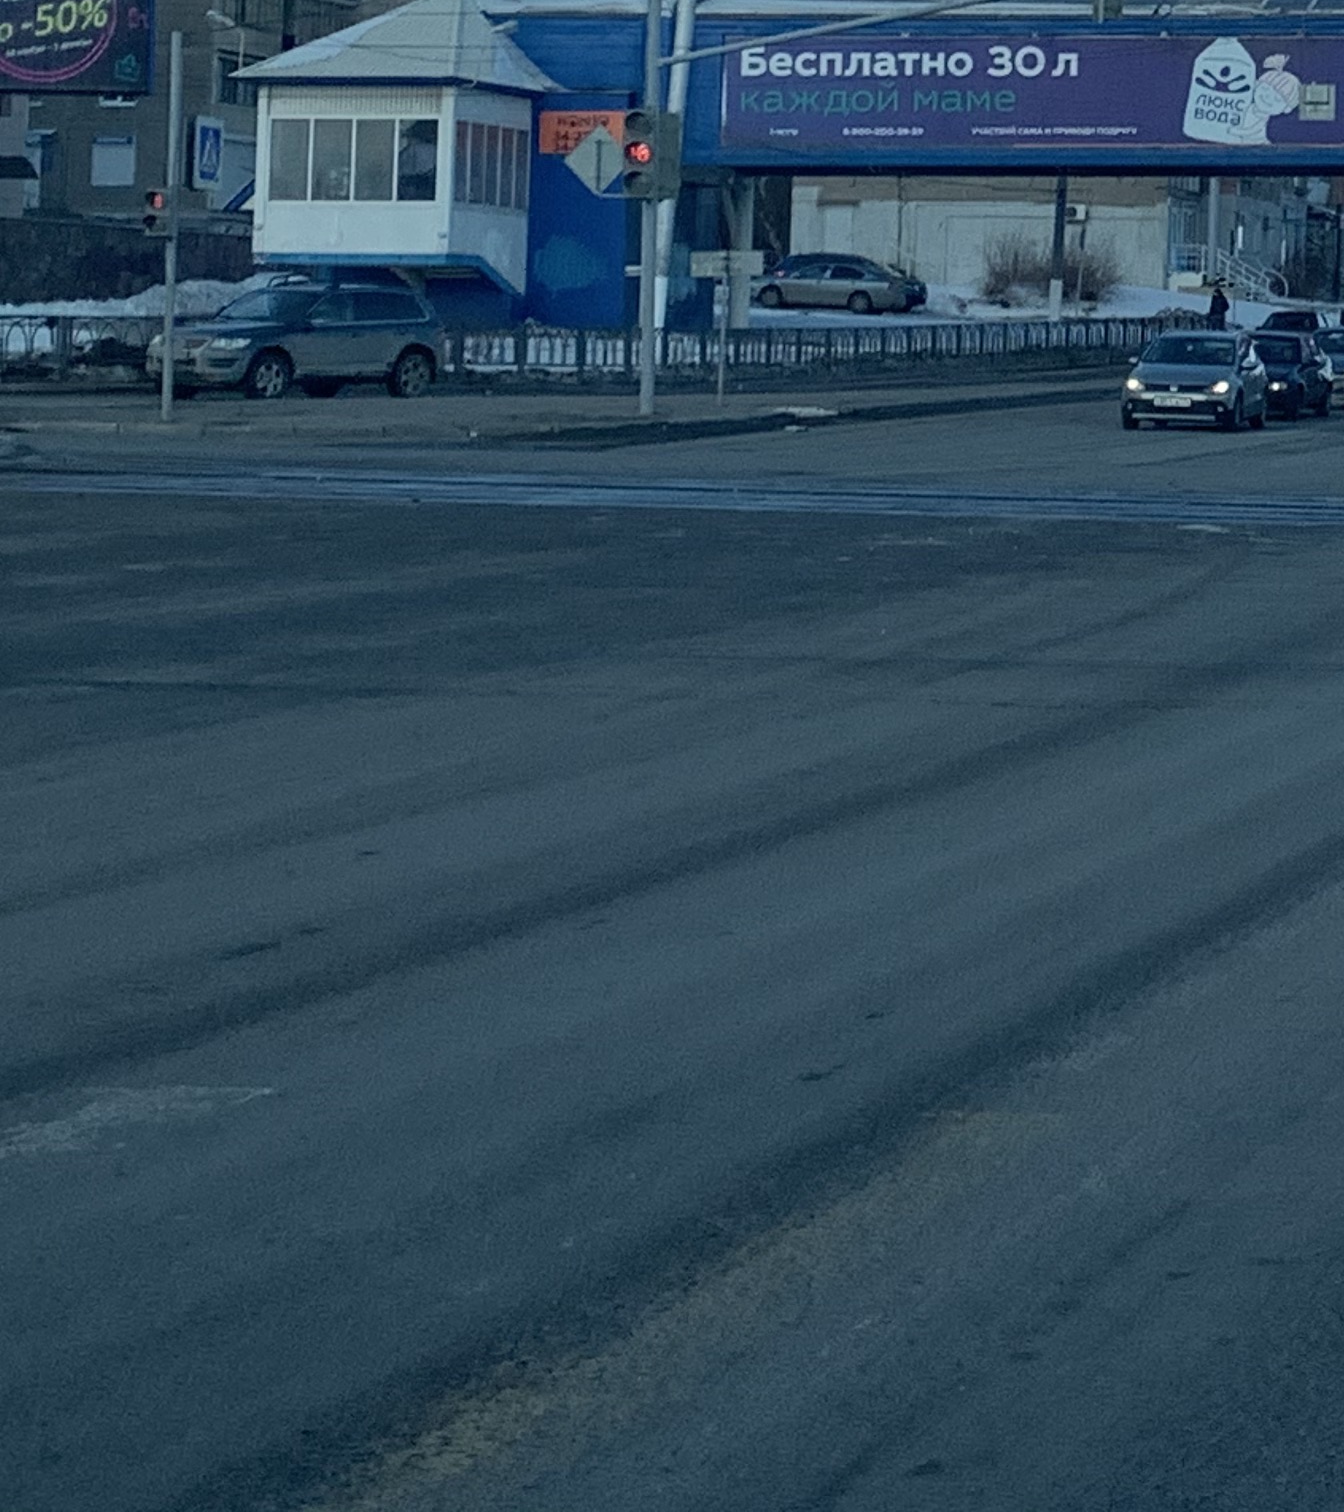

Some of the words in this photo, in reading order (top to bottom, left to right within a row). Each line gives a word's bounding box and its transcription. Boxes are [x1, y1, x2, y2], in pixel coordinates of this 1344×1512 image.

[740, 46, 974, 77] Бесплатно
[987, 46, 1046, 77] 30
[1051, 51, 1080, 77] л
[740, 81, 899, 116] каждой
[913, 89, 1018, 113] маме
